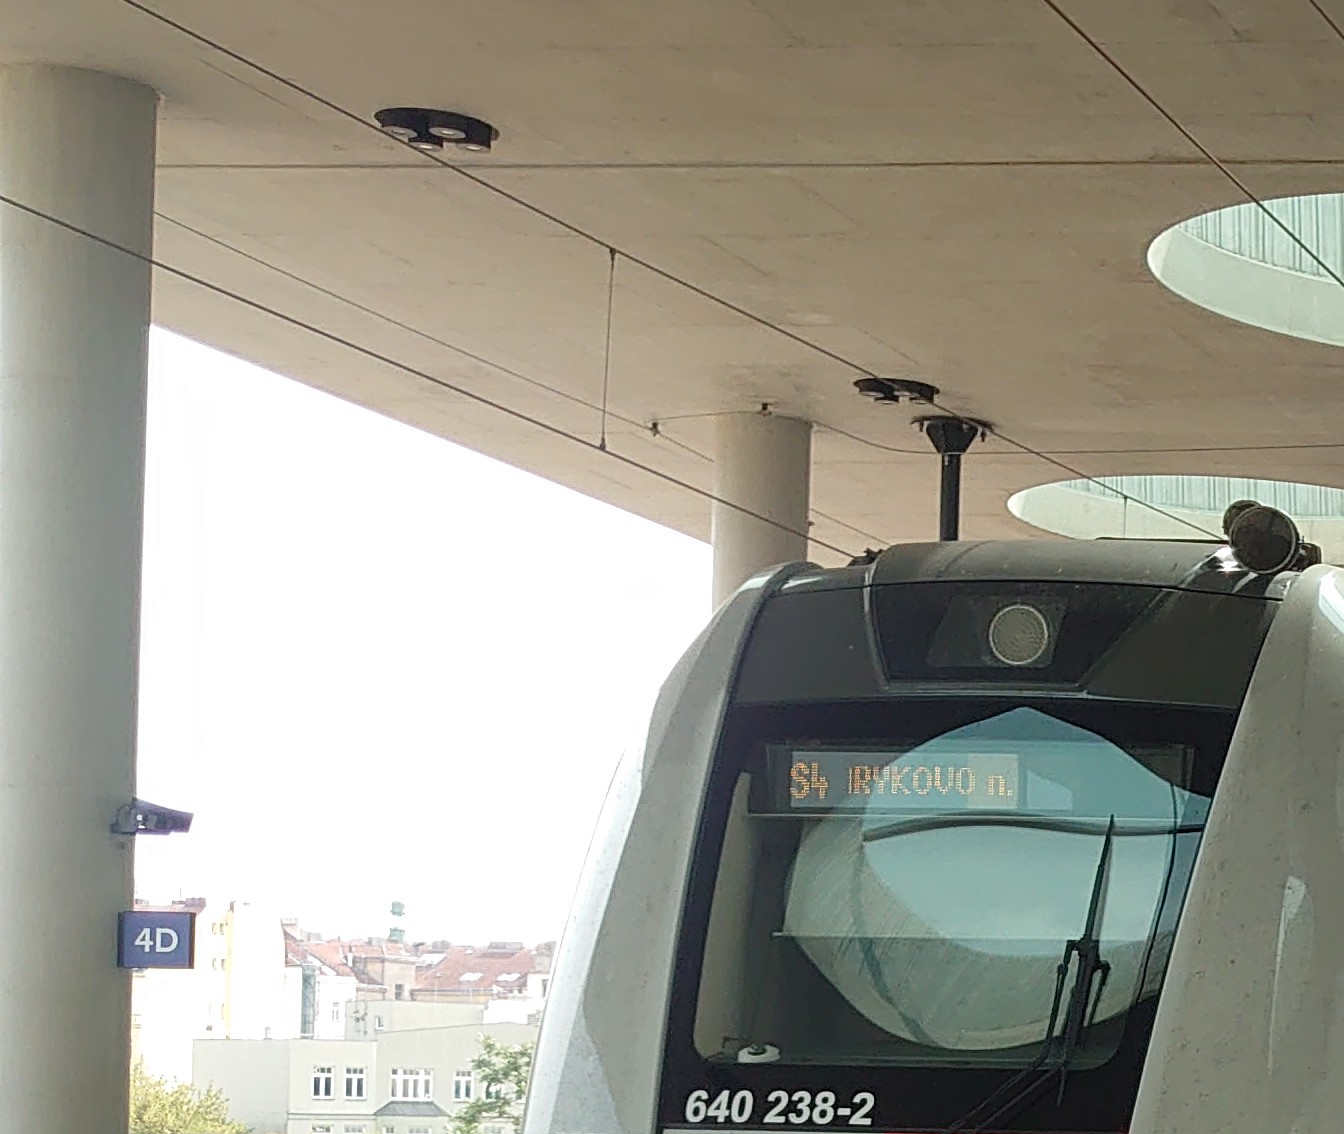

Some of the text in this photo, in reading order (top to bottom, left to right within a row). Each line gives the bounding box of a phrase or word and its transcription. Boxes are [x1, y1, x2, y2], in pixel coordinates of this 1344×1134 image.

[789, 762, 829, 799] S4
[848, 765, 977, 795] RYKOVO
[134, 927, 179, 953] 4D
[685, 1089, 875, 1126] 640 238-2
